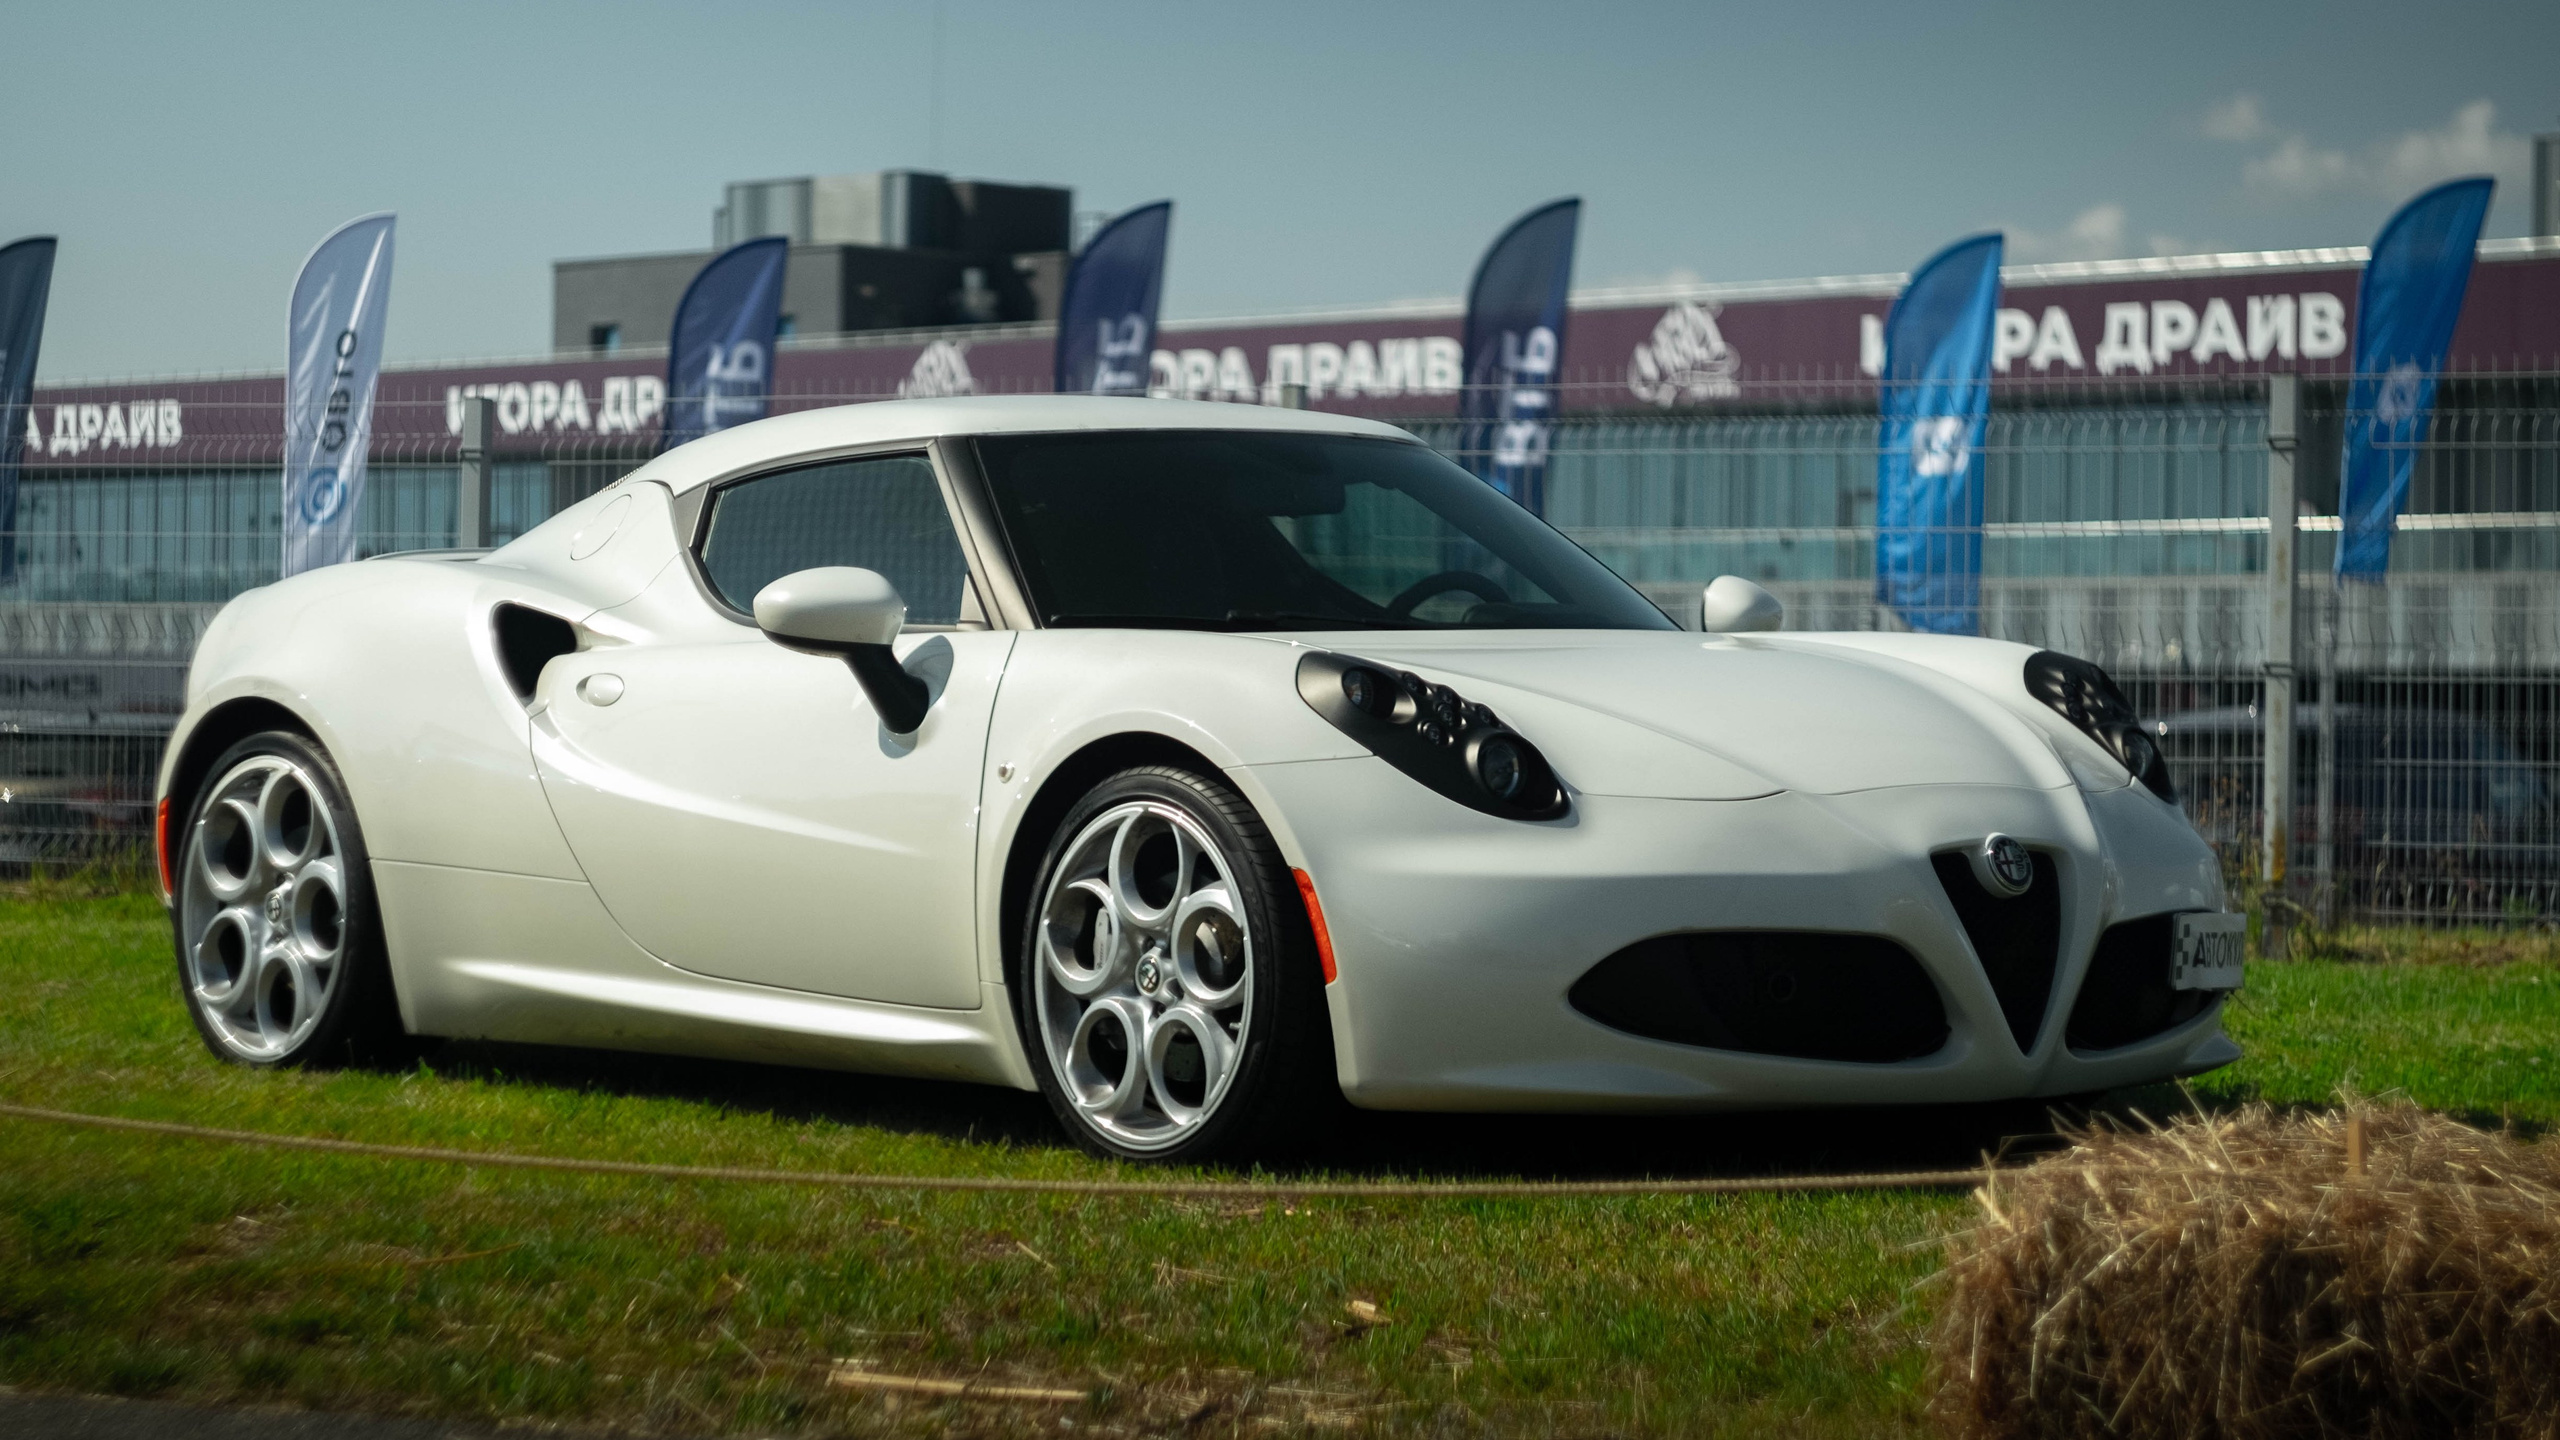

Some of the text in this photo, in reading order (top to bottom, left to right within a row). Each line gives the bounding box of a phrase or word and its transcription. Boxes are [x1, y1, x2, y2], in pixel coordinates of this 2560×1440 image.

[1092, 312, 1148, 396] ТБ
[1145, 336, 1464, 407] ОРА ДРАЙВ
[2096, 291, 2347, 375] ДРАЙВ
[704, 338, 768, 433] ТБ
[1493, 325, 1557, 466] ВТБ
[51, 398, 183, 458] ДРАЙВ
